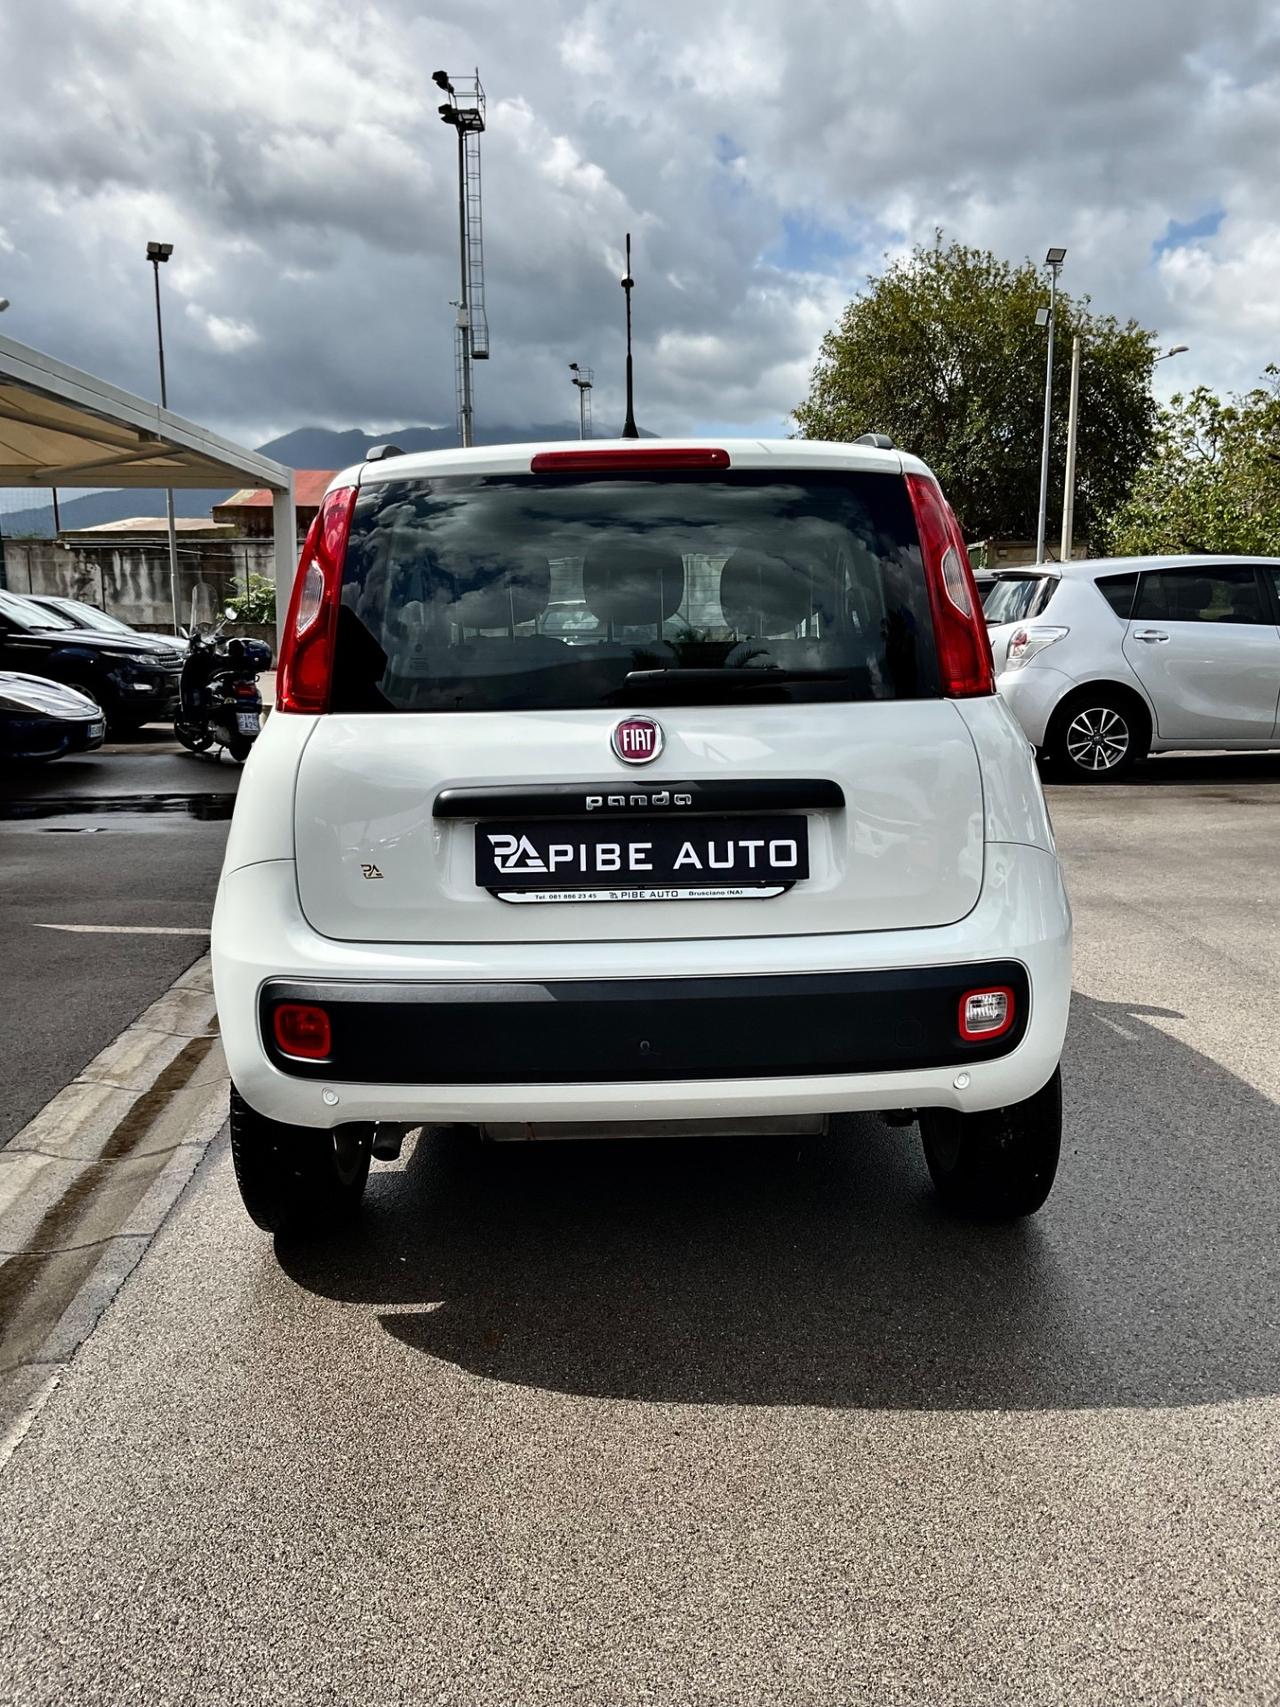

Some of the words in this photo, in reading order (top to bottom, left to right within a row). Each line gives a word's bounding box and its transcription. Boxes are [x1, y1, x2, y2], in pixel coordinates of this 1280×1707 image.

[622, 729, 653, 751] FIAT
[586, 791, 692, 811] panda
[549, 843, 653, 872] PIBE
[672, 839, 798, 869] AUTO
[620, 891, 645, 899] PIBE
[649, 890, 679, 898] AUTO
